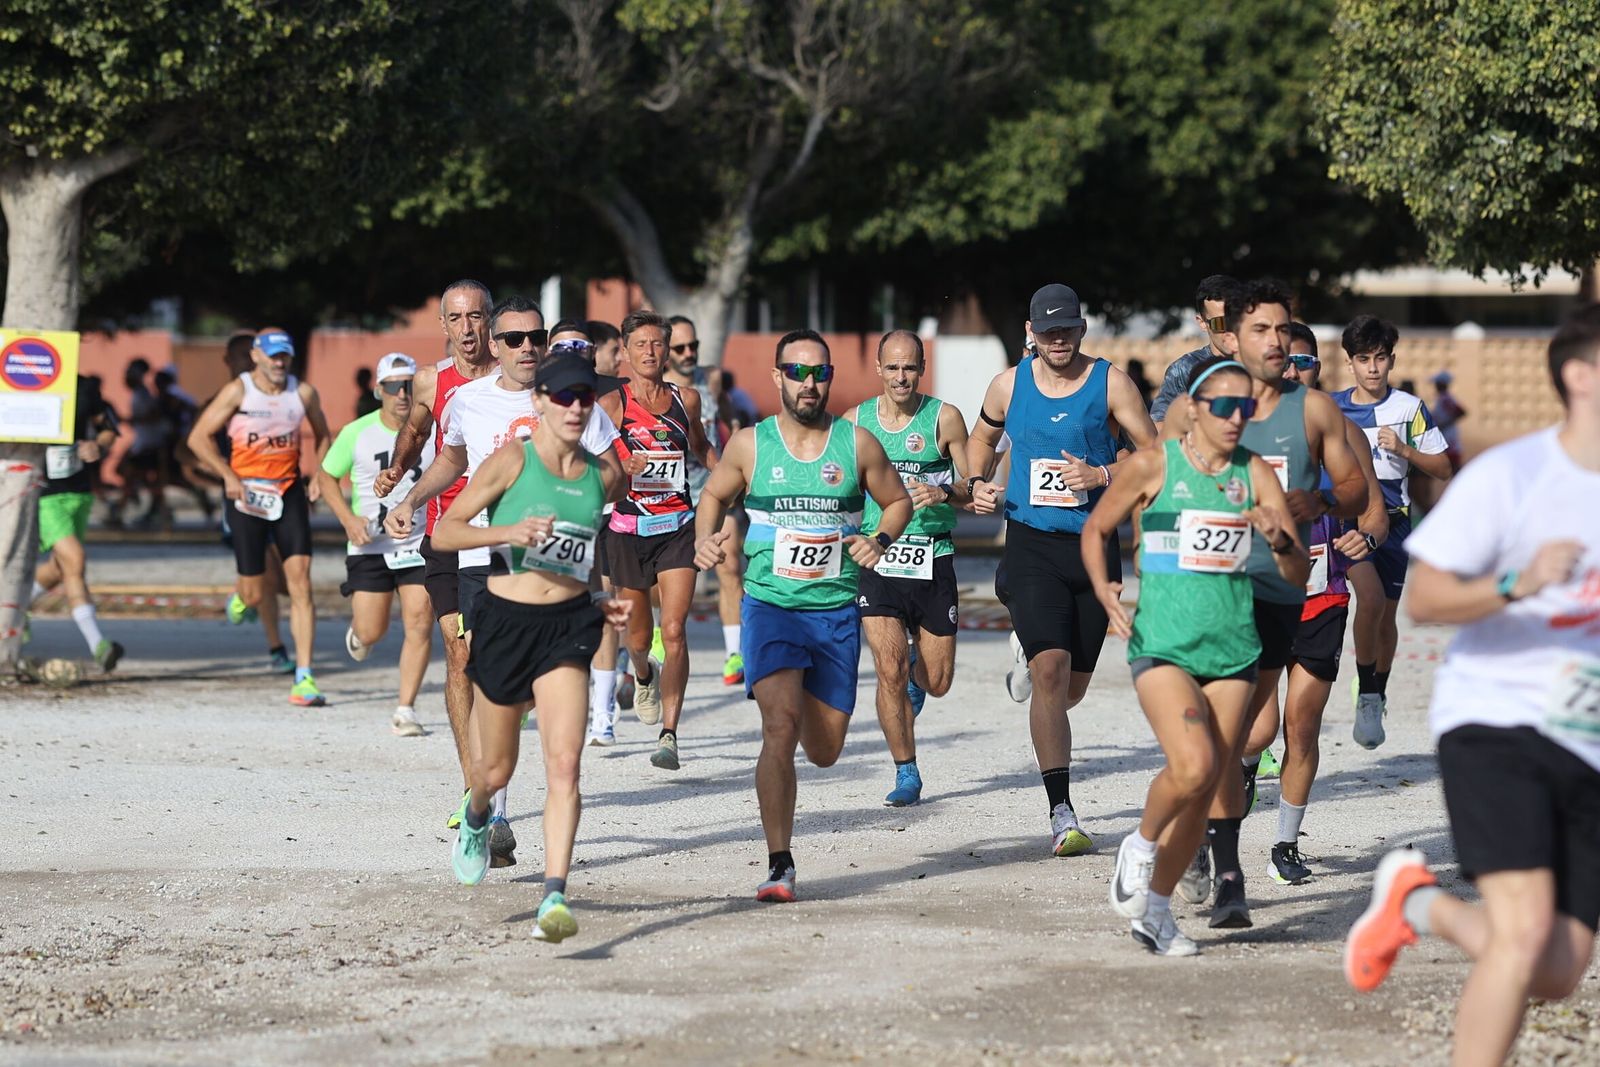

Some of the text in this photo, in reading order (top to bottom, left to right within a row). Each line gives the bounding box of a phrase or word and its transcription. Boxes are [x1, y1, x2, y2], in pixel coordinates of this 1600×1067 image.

[641, 462, 679, 479] 241
[774, 497, 840, 511] ATLETISMO
[539, 535, 586, 563] 790
[1193, 528, 1246, 553] 327
[789, 545, 833, 567] 182
[884, 545, 926, 566] 658
